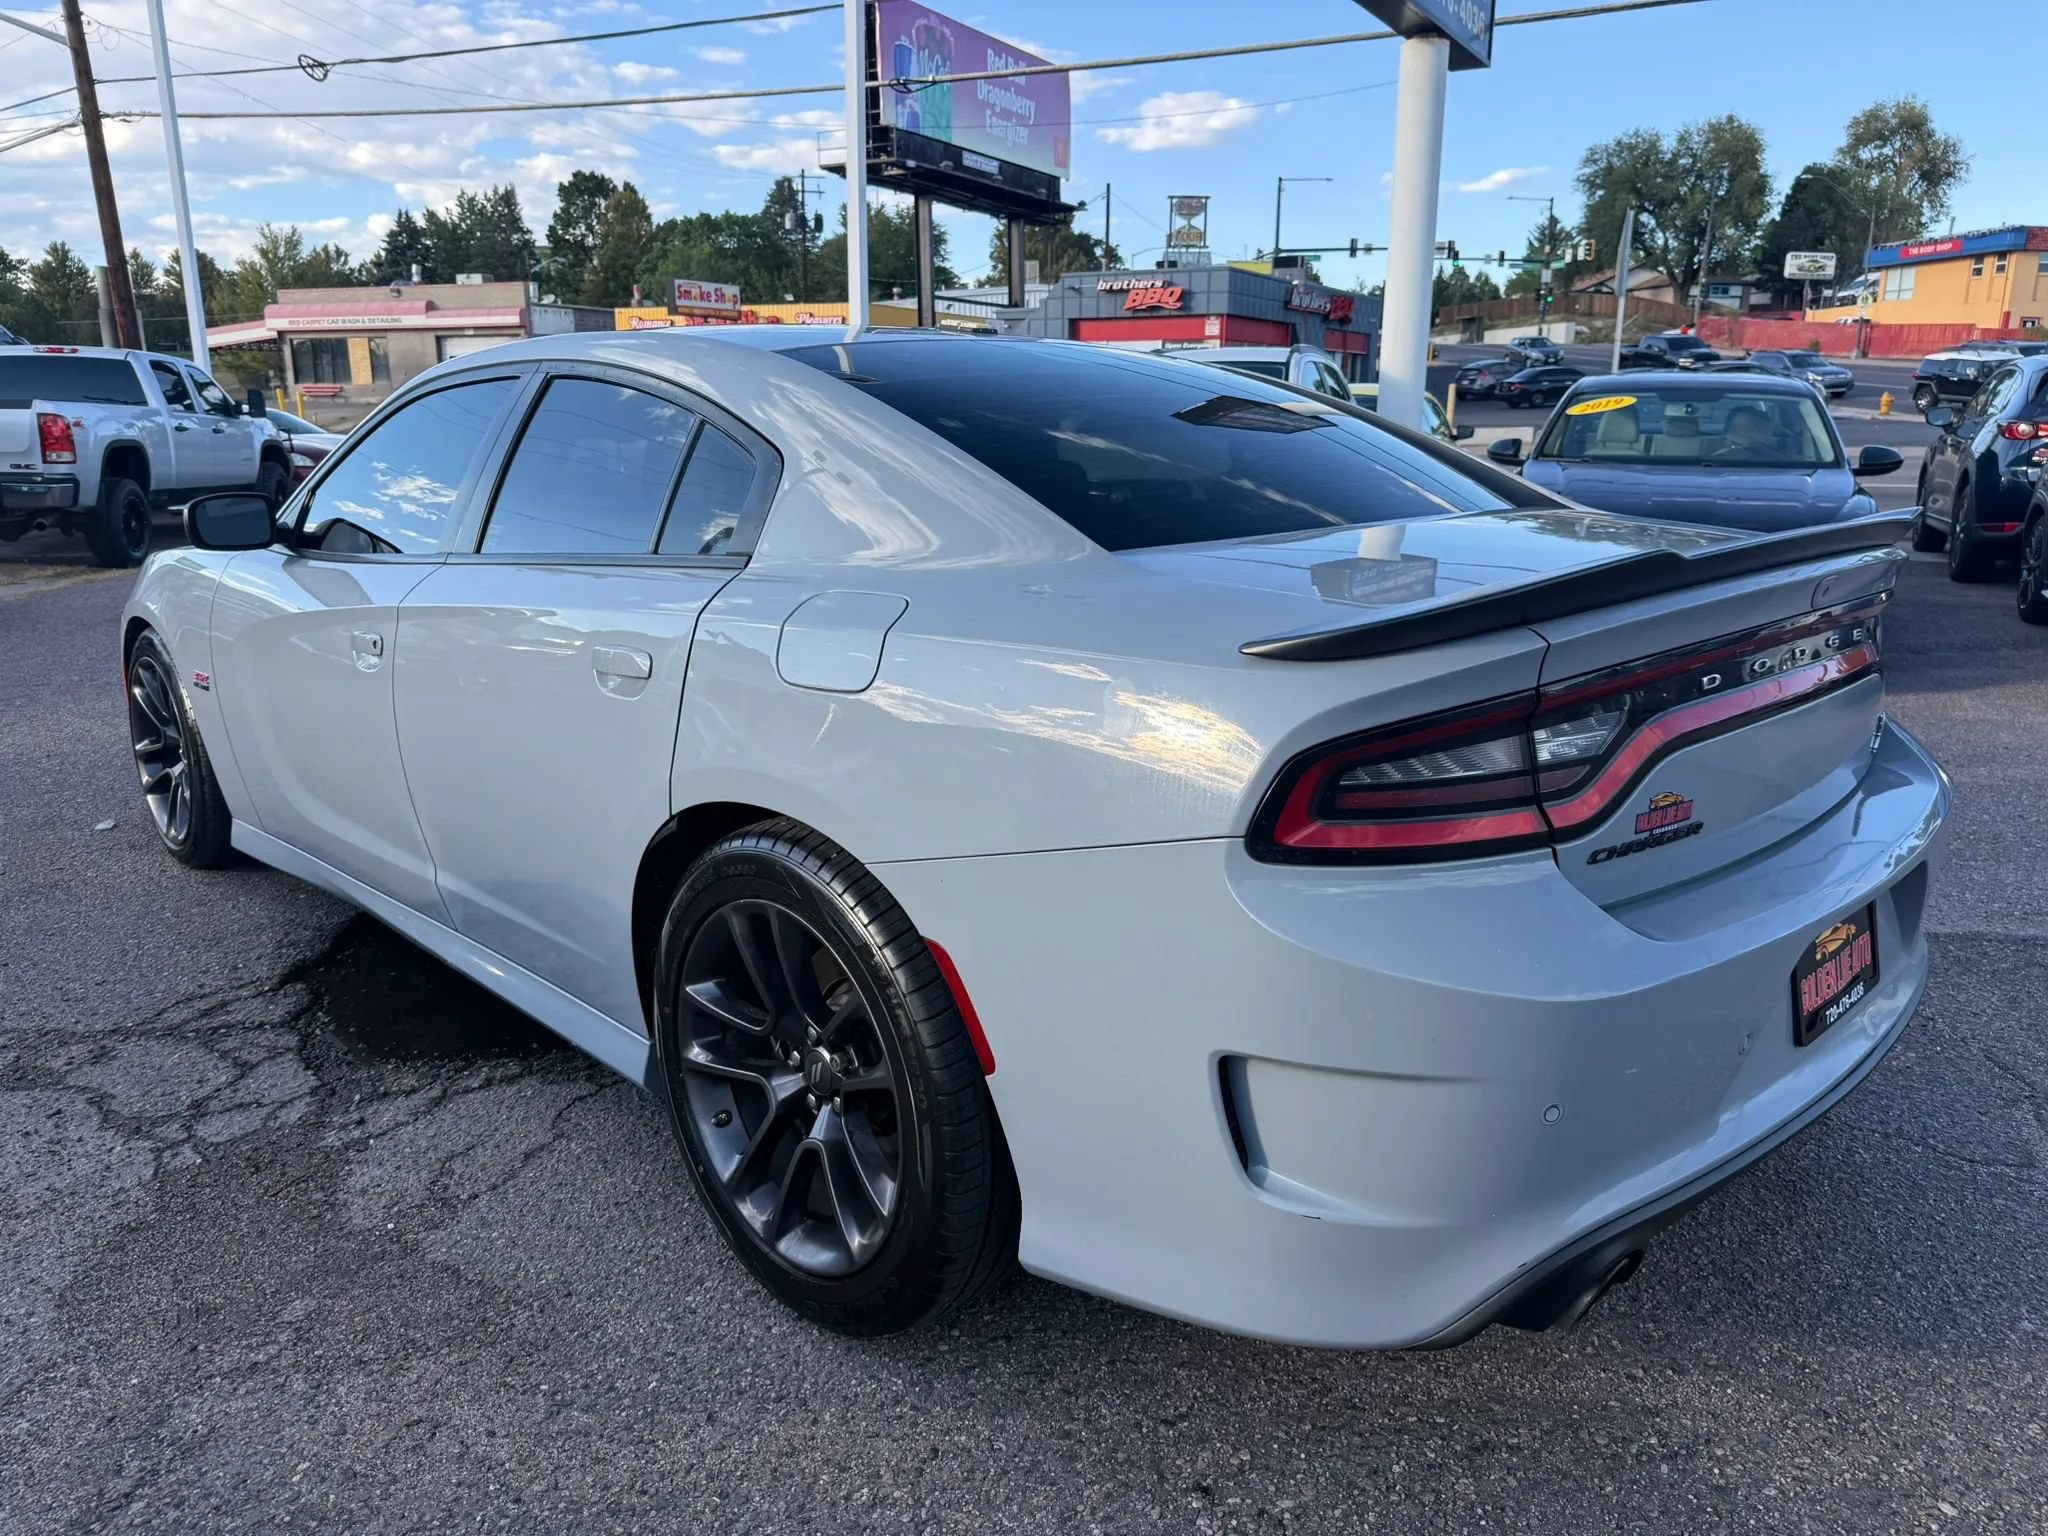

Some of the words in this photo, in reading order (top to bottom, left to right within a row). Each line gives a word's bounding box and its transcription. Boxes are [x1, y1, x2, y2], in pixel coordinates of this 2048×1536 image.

[987, 48, 1006, 73] Red
[977, 79, 1036, 125] Dragonberry
[986, 109, 1028, 147] Energizer
[1909, 247, 1919, 255] THE
[1920, 245, 1935, 254] BODY
[1936, 242, 1953, 252] SHOP
[677, 284, 712, 302] Smoke
[714, 288, 739, 309] Shop
[1097, 278, 1165, 290] brothers
[1124, 288, 1184, 311] BBQ
[629, 316, 673, 329] Romance
[795, 312, 844, 324] Pleasures
[1579, 398, 1624, 413] 2019
[1702, 628, 1865, 690] DODGE
[1587, 820, 1704, 865] CHARGER
